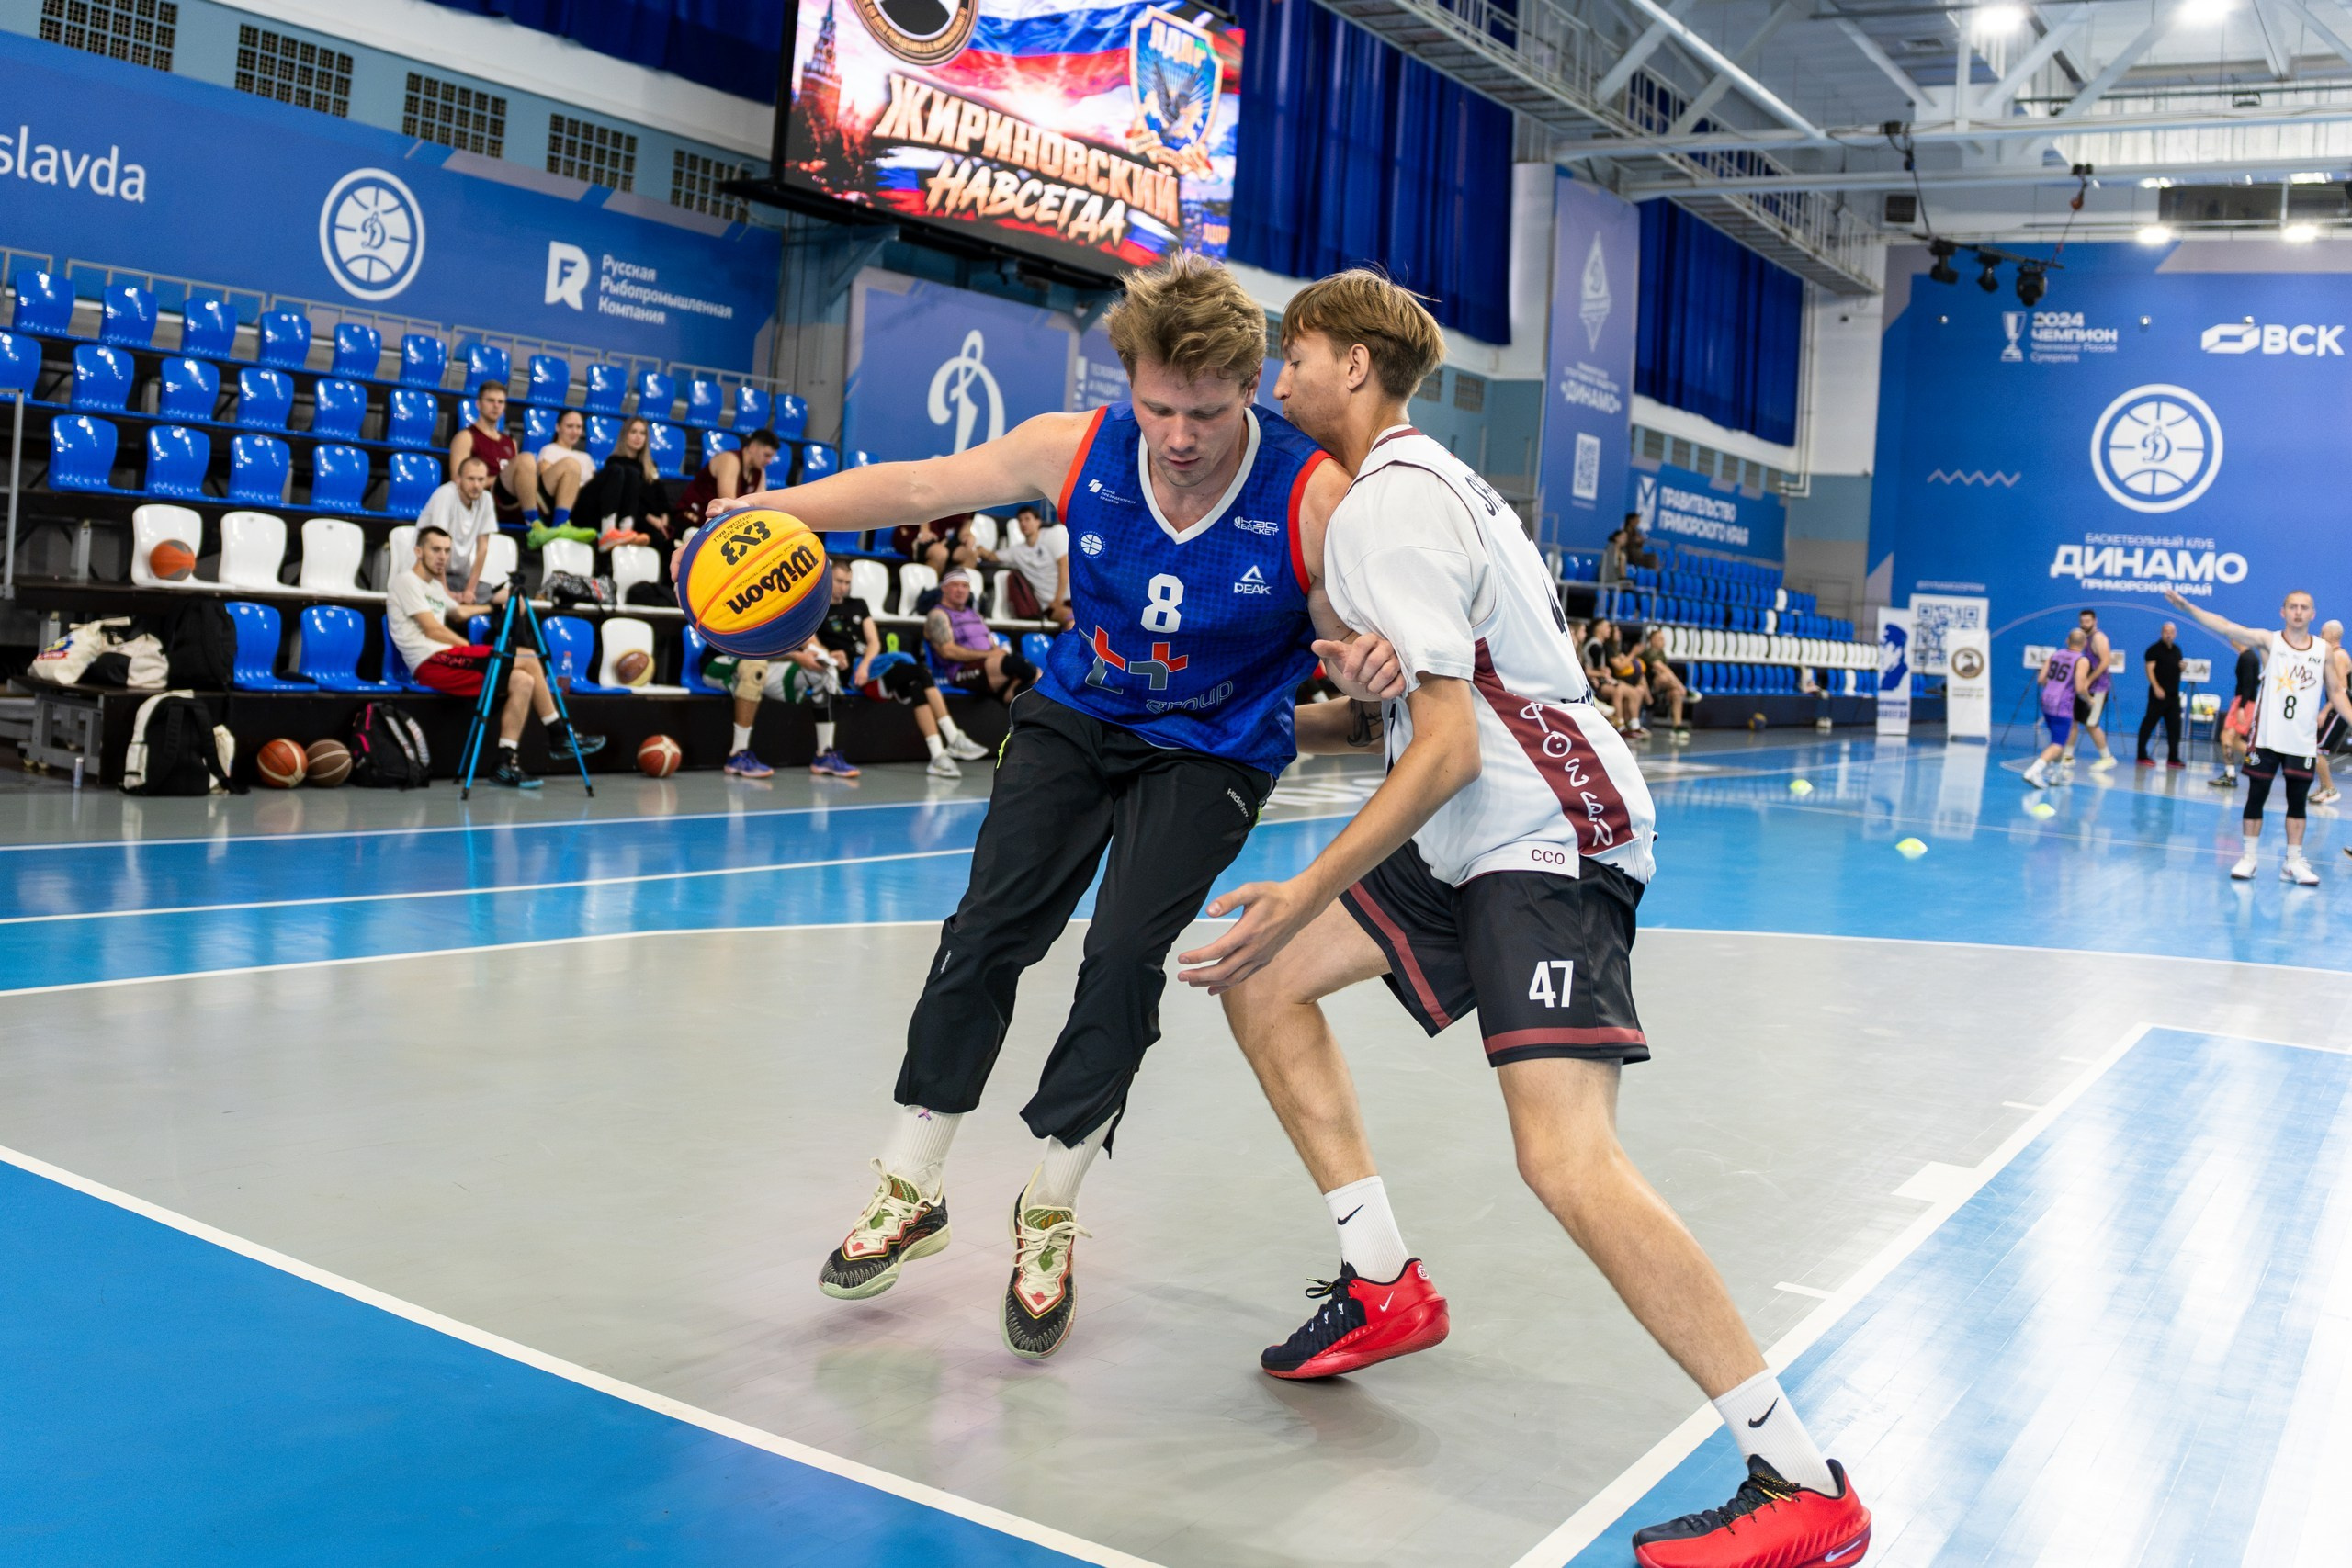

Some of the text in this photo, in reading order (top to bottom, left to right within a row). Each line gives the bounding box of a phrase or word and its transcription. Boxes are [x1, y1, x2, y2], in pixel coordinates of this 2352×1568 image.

[0, 125, 145, 203] slavda
[872, 73, 1181, 228] ЖИРИНОВСКИЙ
[924, 158, 1127, 246] НАВСЕГДА
[601, 254, 657, 282] Русская
[598, 296, 667, 325] Компания
[599, 275, 733, 320] Рыбопромышленная
[2032, 311, 2085, 328] 2024
[2030, 328, 2118, 343] ЧЕМПИОН
[2085, 532, 2216, 550] БАСКЕТБОЛЬНЫЙ КЛУБ
[2050, 544, 2248, 584] ДИНАМО
[726, 545, 819, 615] Wilson
[1233, 581, 1273, 595] PEAK
[2174, 581, 2212, 596] КРАЙ
[1140, 572, 1185, 633] 8
[2047, 660, 2071, 682] 96
[2284, 695, 2297, 719] 8
[1529, 960, 1574, 1008] 47
